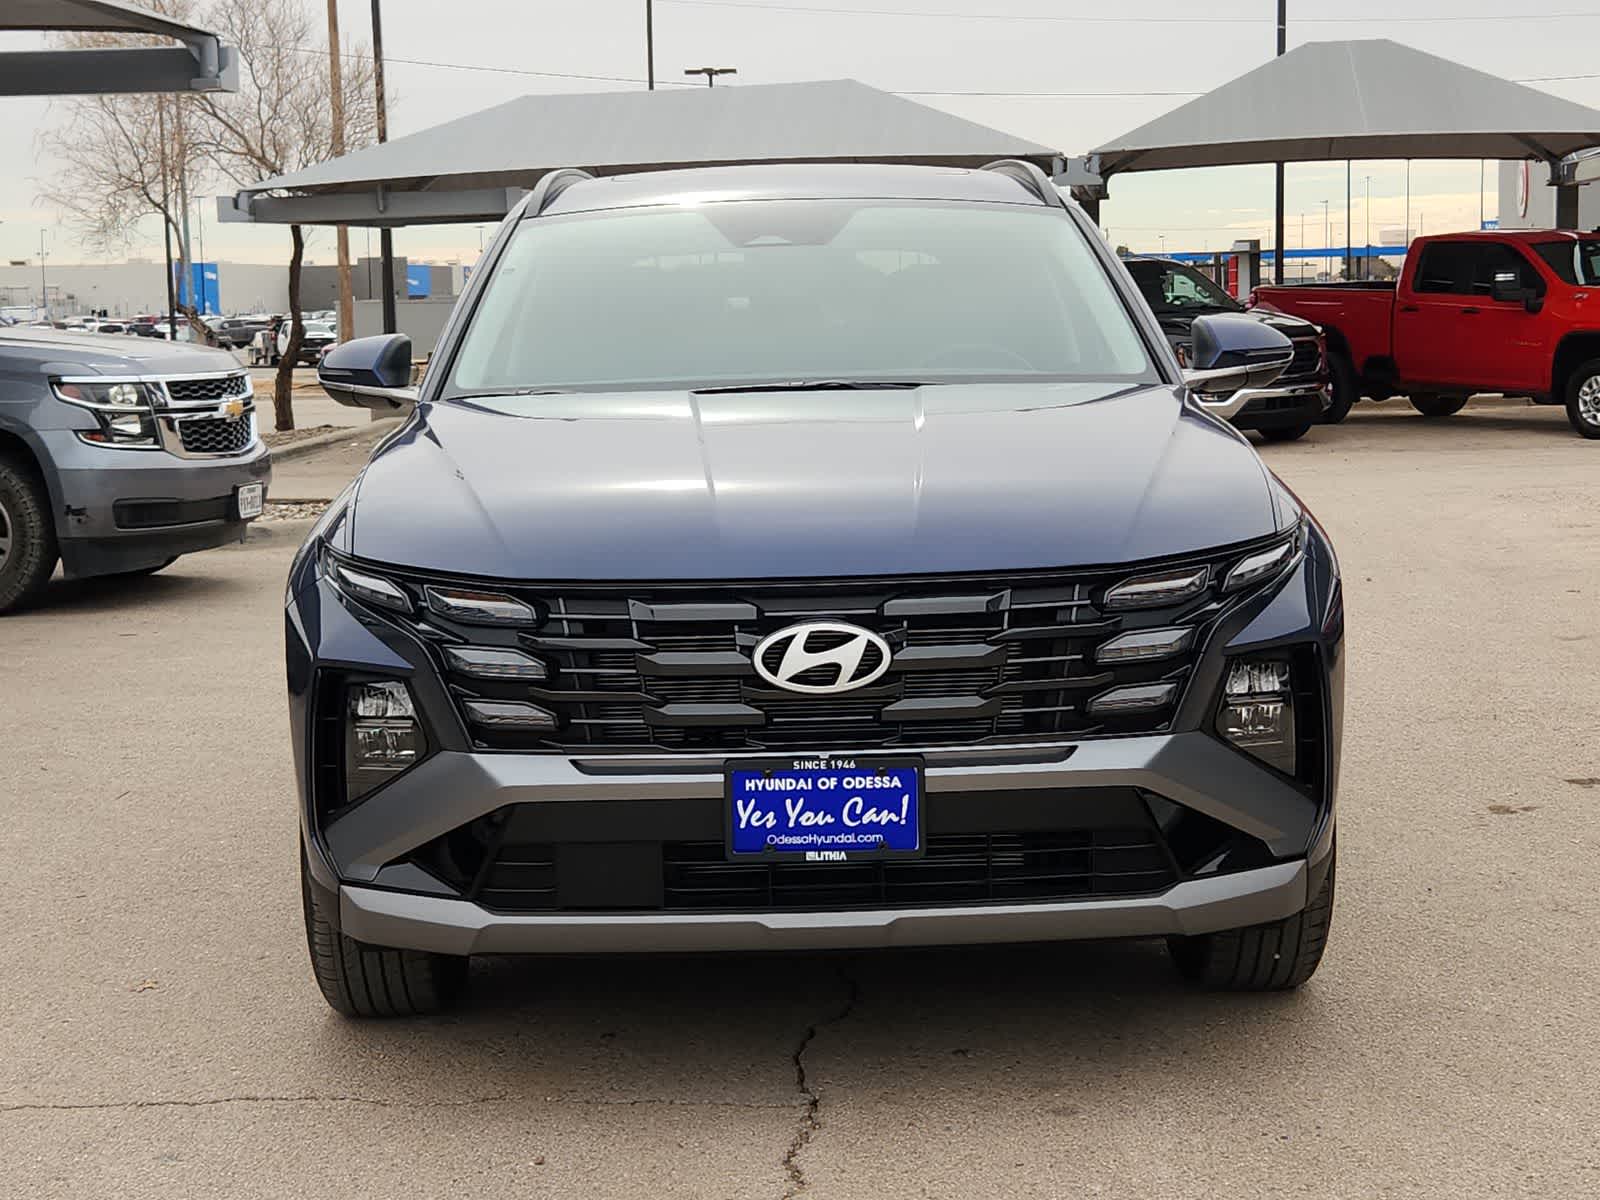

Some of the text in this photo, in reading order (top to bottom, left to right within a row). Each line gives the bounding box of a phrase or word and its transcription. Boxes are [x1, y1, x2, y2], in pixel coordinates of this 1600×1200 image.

[793, 760, 856, 770] SINCE 1946
[745, 776, 902, 791] HYUNDAI OF ODESSA
[736, 794, 910, 829] Yes You Can!
[766, 833, 884, 847] OdessaHyundai.com
[814, 851, 847, 861] LITHIA
